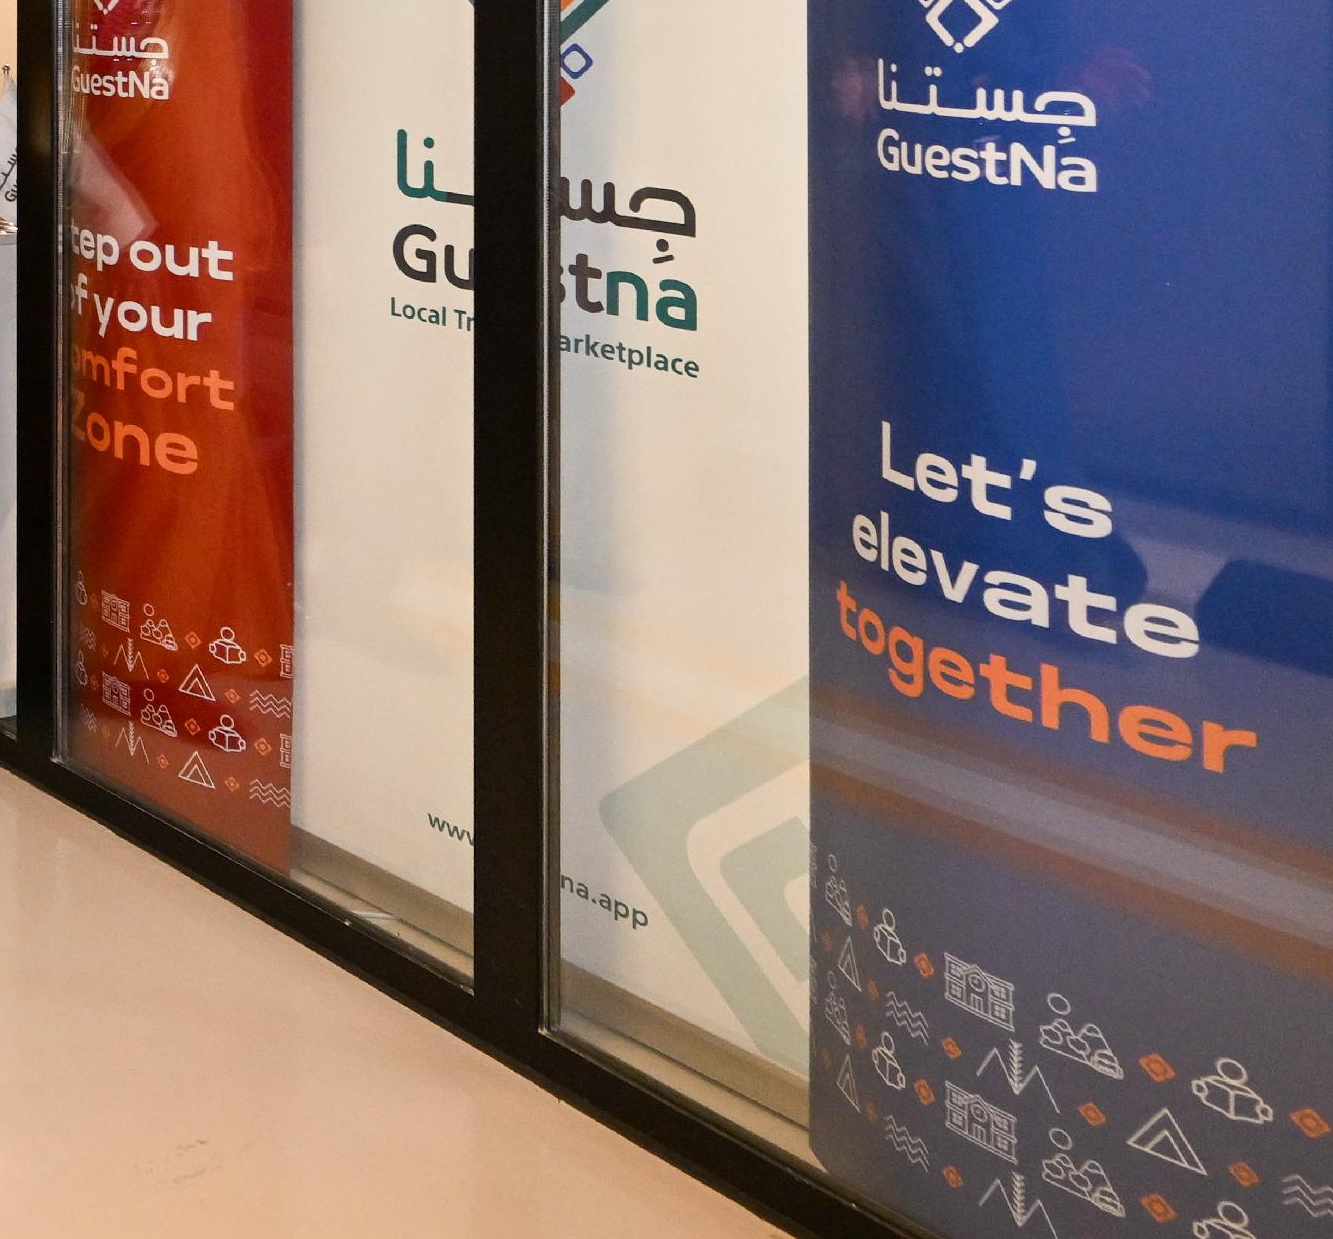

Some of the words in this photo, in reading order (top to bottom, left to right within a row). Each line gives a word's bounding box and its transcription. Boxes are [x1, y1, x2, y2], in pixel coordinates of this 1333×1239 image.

[73, 65, 170, 100] GuestNa
[877, 128, 1097, 192] GuestNa
[70, 218, 120, 272] tep
[129, 240, 234, 282] out
[392, 223, 698, 332] Gutna
[93, 293, 213, 342] your
[390, 297, 447, 327] Local
[558, 334, 700, 379] arketplace
[72, 344, 235, 411] omfort
[881, 420, 1113, 539] Let's
[852, 510, 1200, 659] elevate
[836, 580, 1258, 774] together
